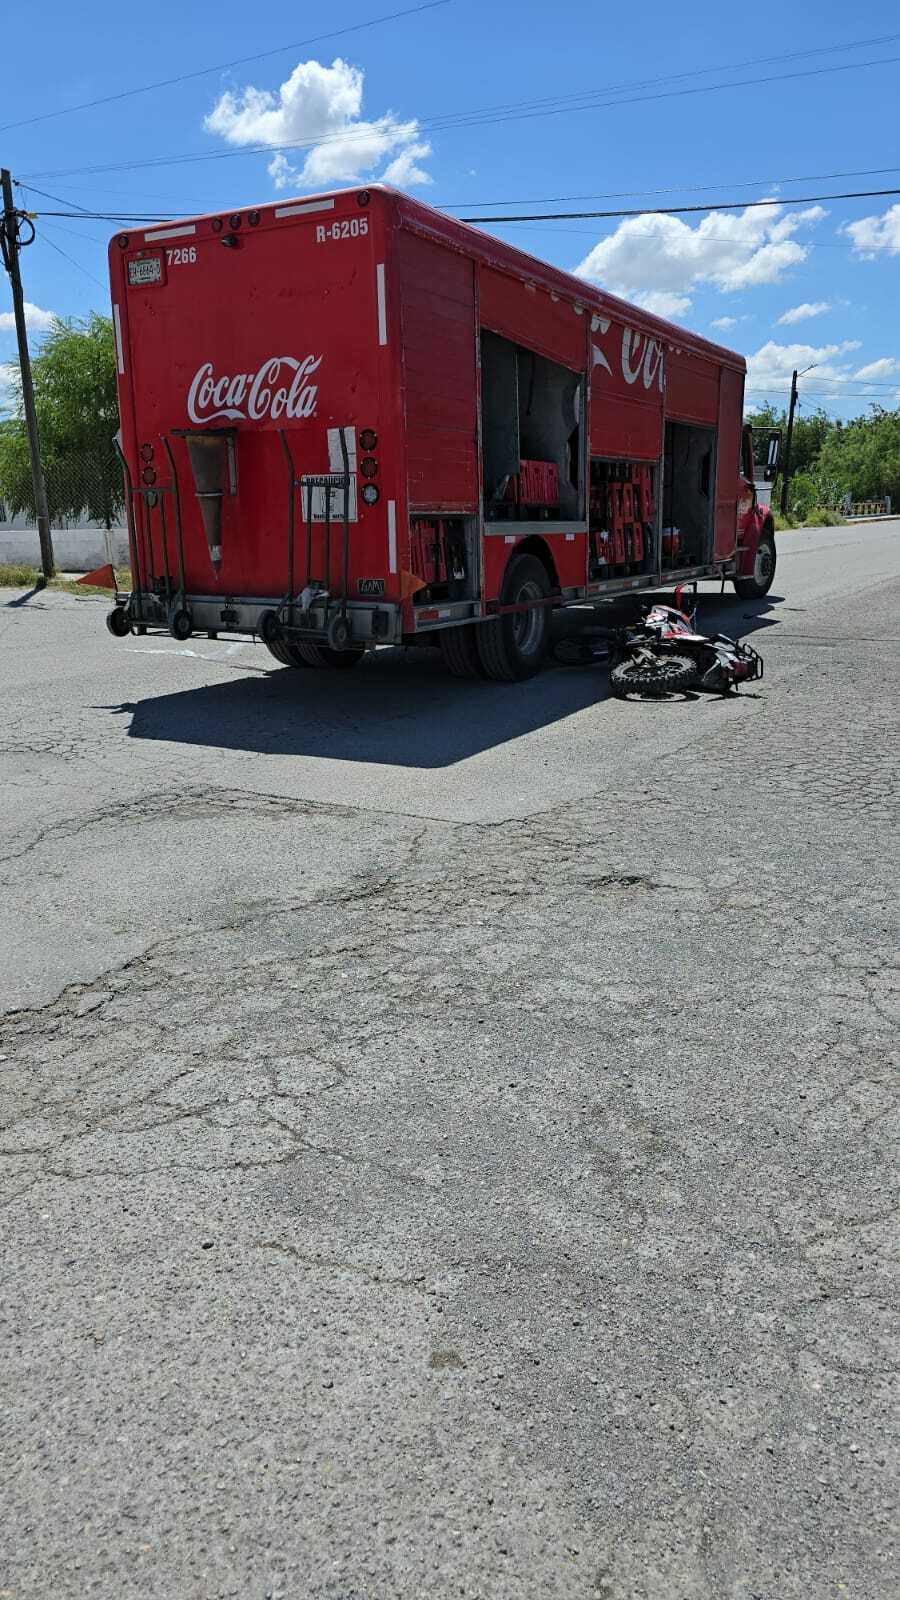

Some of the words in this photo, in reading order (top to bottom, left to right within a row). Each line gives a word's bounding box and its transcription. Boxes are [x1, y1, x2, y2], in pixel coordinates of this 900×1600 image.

[316, 216, 369, 243] R-6205
[166, 246, 197, 266] 7266
[188, 354, 324, 423] Coca-Cola
